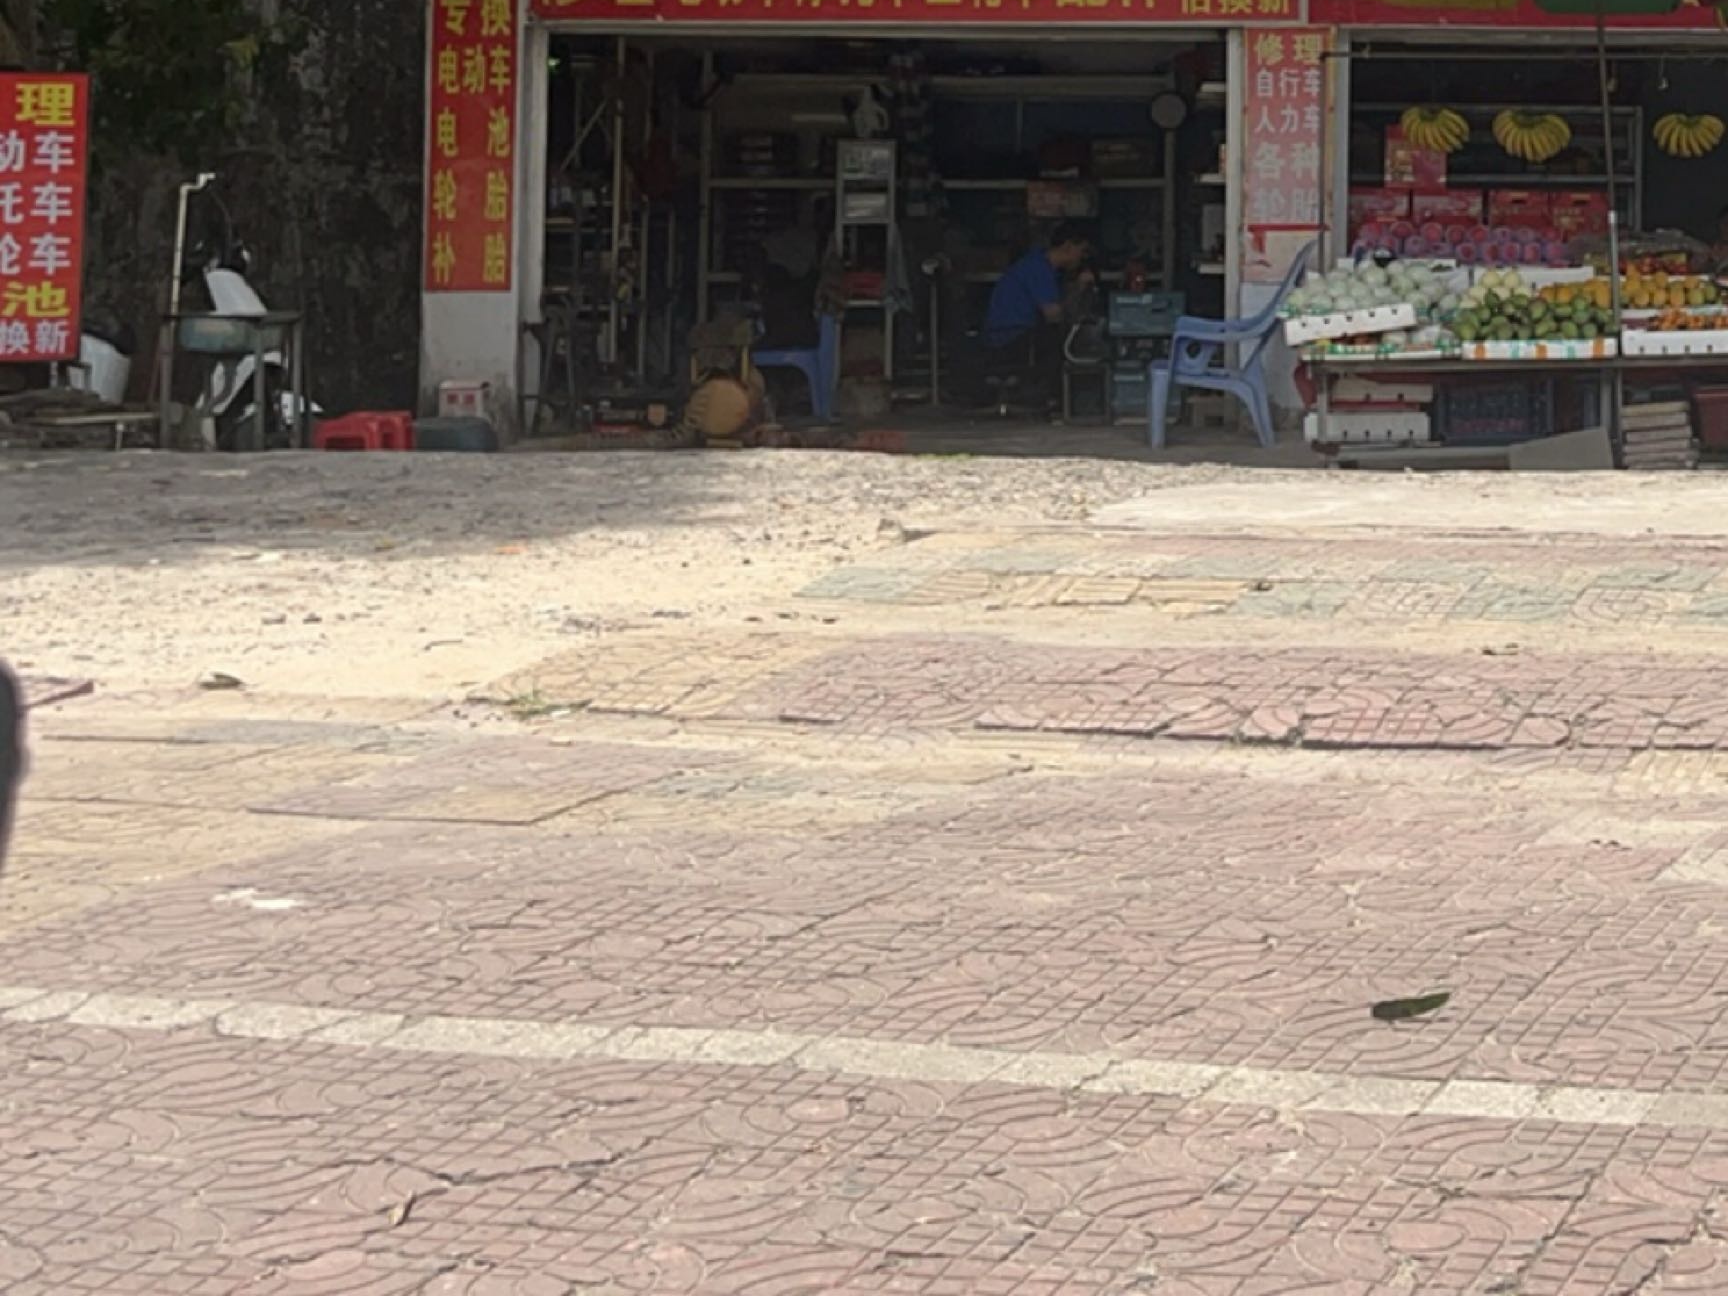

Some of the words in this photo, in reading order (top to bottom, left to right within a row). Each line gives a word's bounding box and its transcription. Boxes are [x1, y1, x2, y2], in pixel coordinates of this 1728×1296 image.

[1254, 33, 1324, 66] 修理
[438, 44, 512, 95] 电动车
[1256, 69, 1322, 98] 自行车
[15, 83, 75, 127] 理
[1254, 107, 1322, 134] 人力车
[436, 107, 511, 157] 电池
[1253, 142, 1321, 181] 各种
[432, 168, 508, 221] 轮胎
[431, 232, 506, 284] 补胎
[1, 280, 70, 318] 池
[0, 319, 70, 354] 换新
